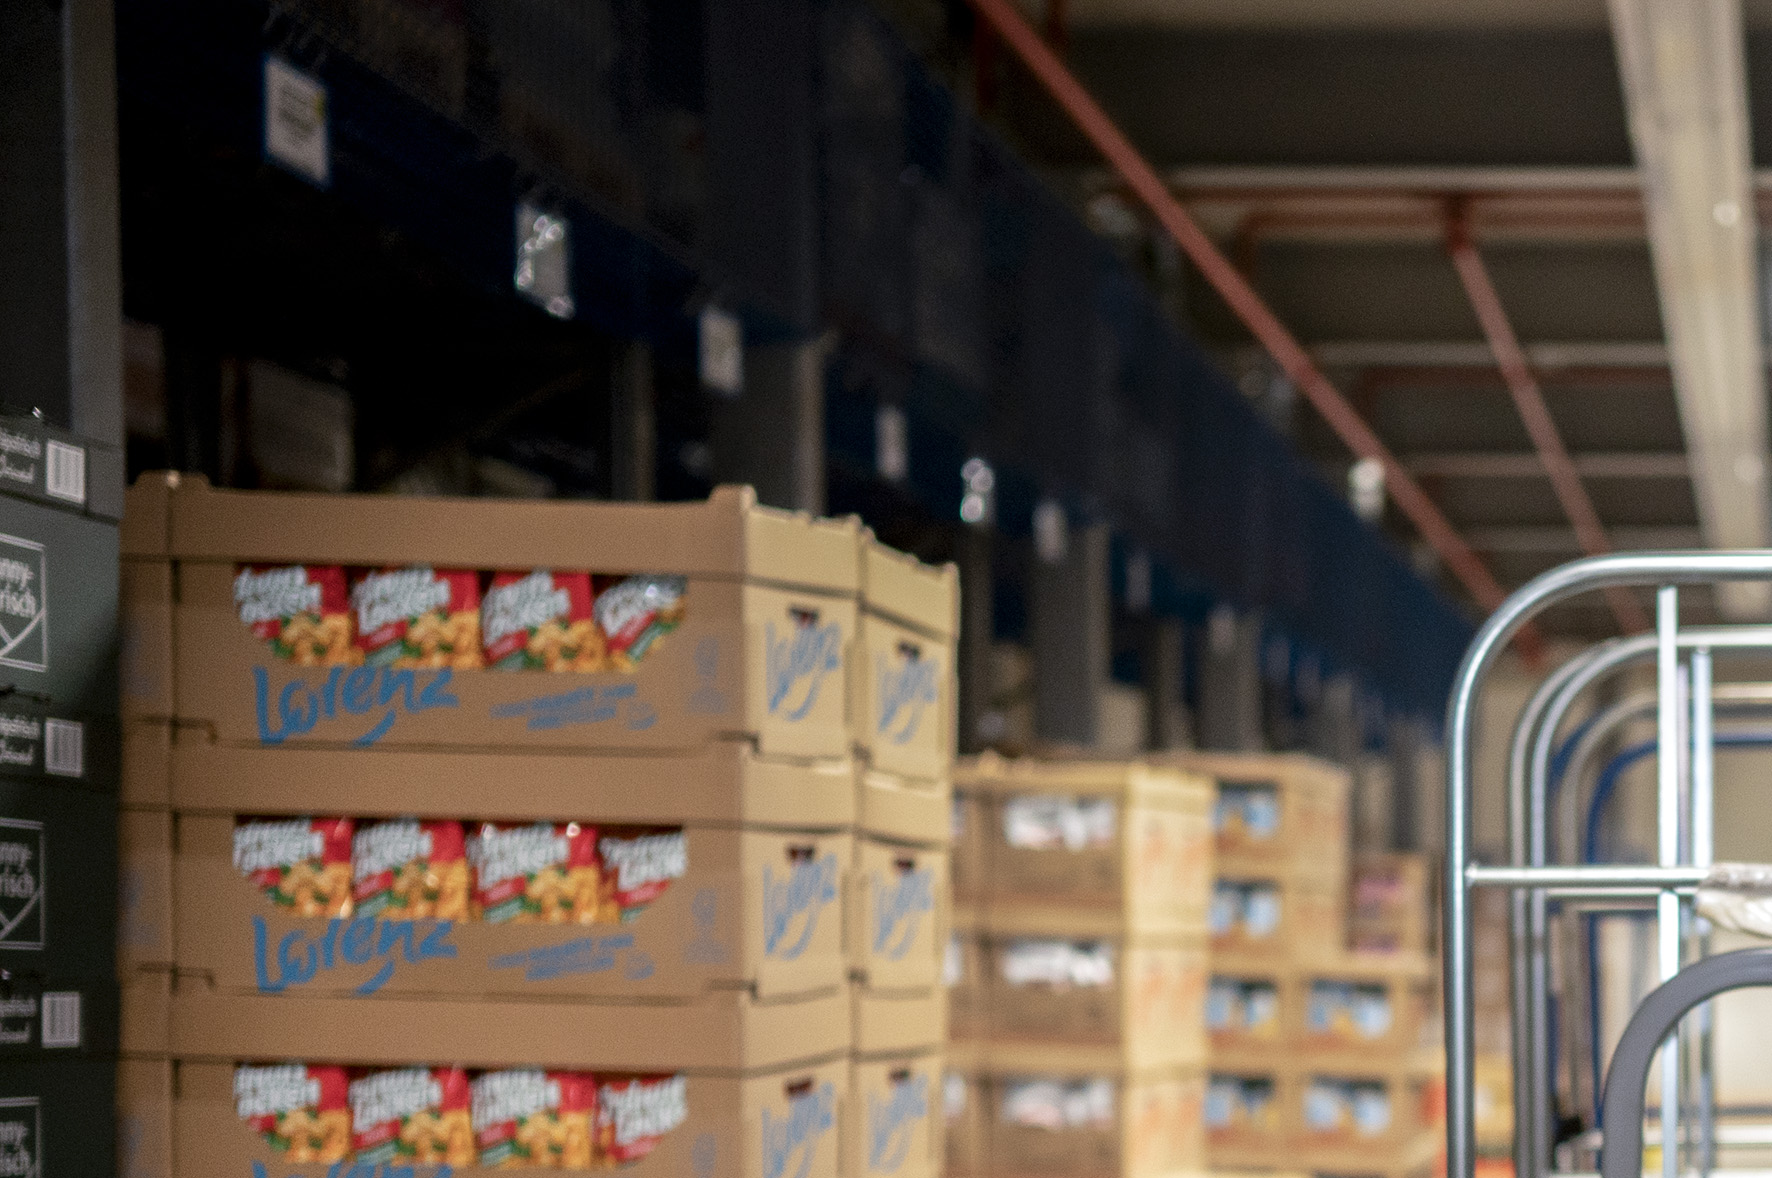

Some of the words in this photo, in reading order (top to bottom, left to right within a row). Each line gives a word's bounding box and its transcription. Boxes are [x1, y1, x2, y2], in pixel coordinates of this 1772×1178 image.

[0, 583, 36, 619] risch
[252, 667, 459, 747] Lorenz
[0, 864, 35, 899] risch
[252, 914, 457, 995] Lorenz
